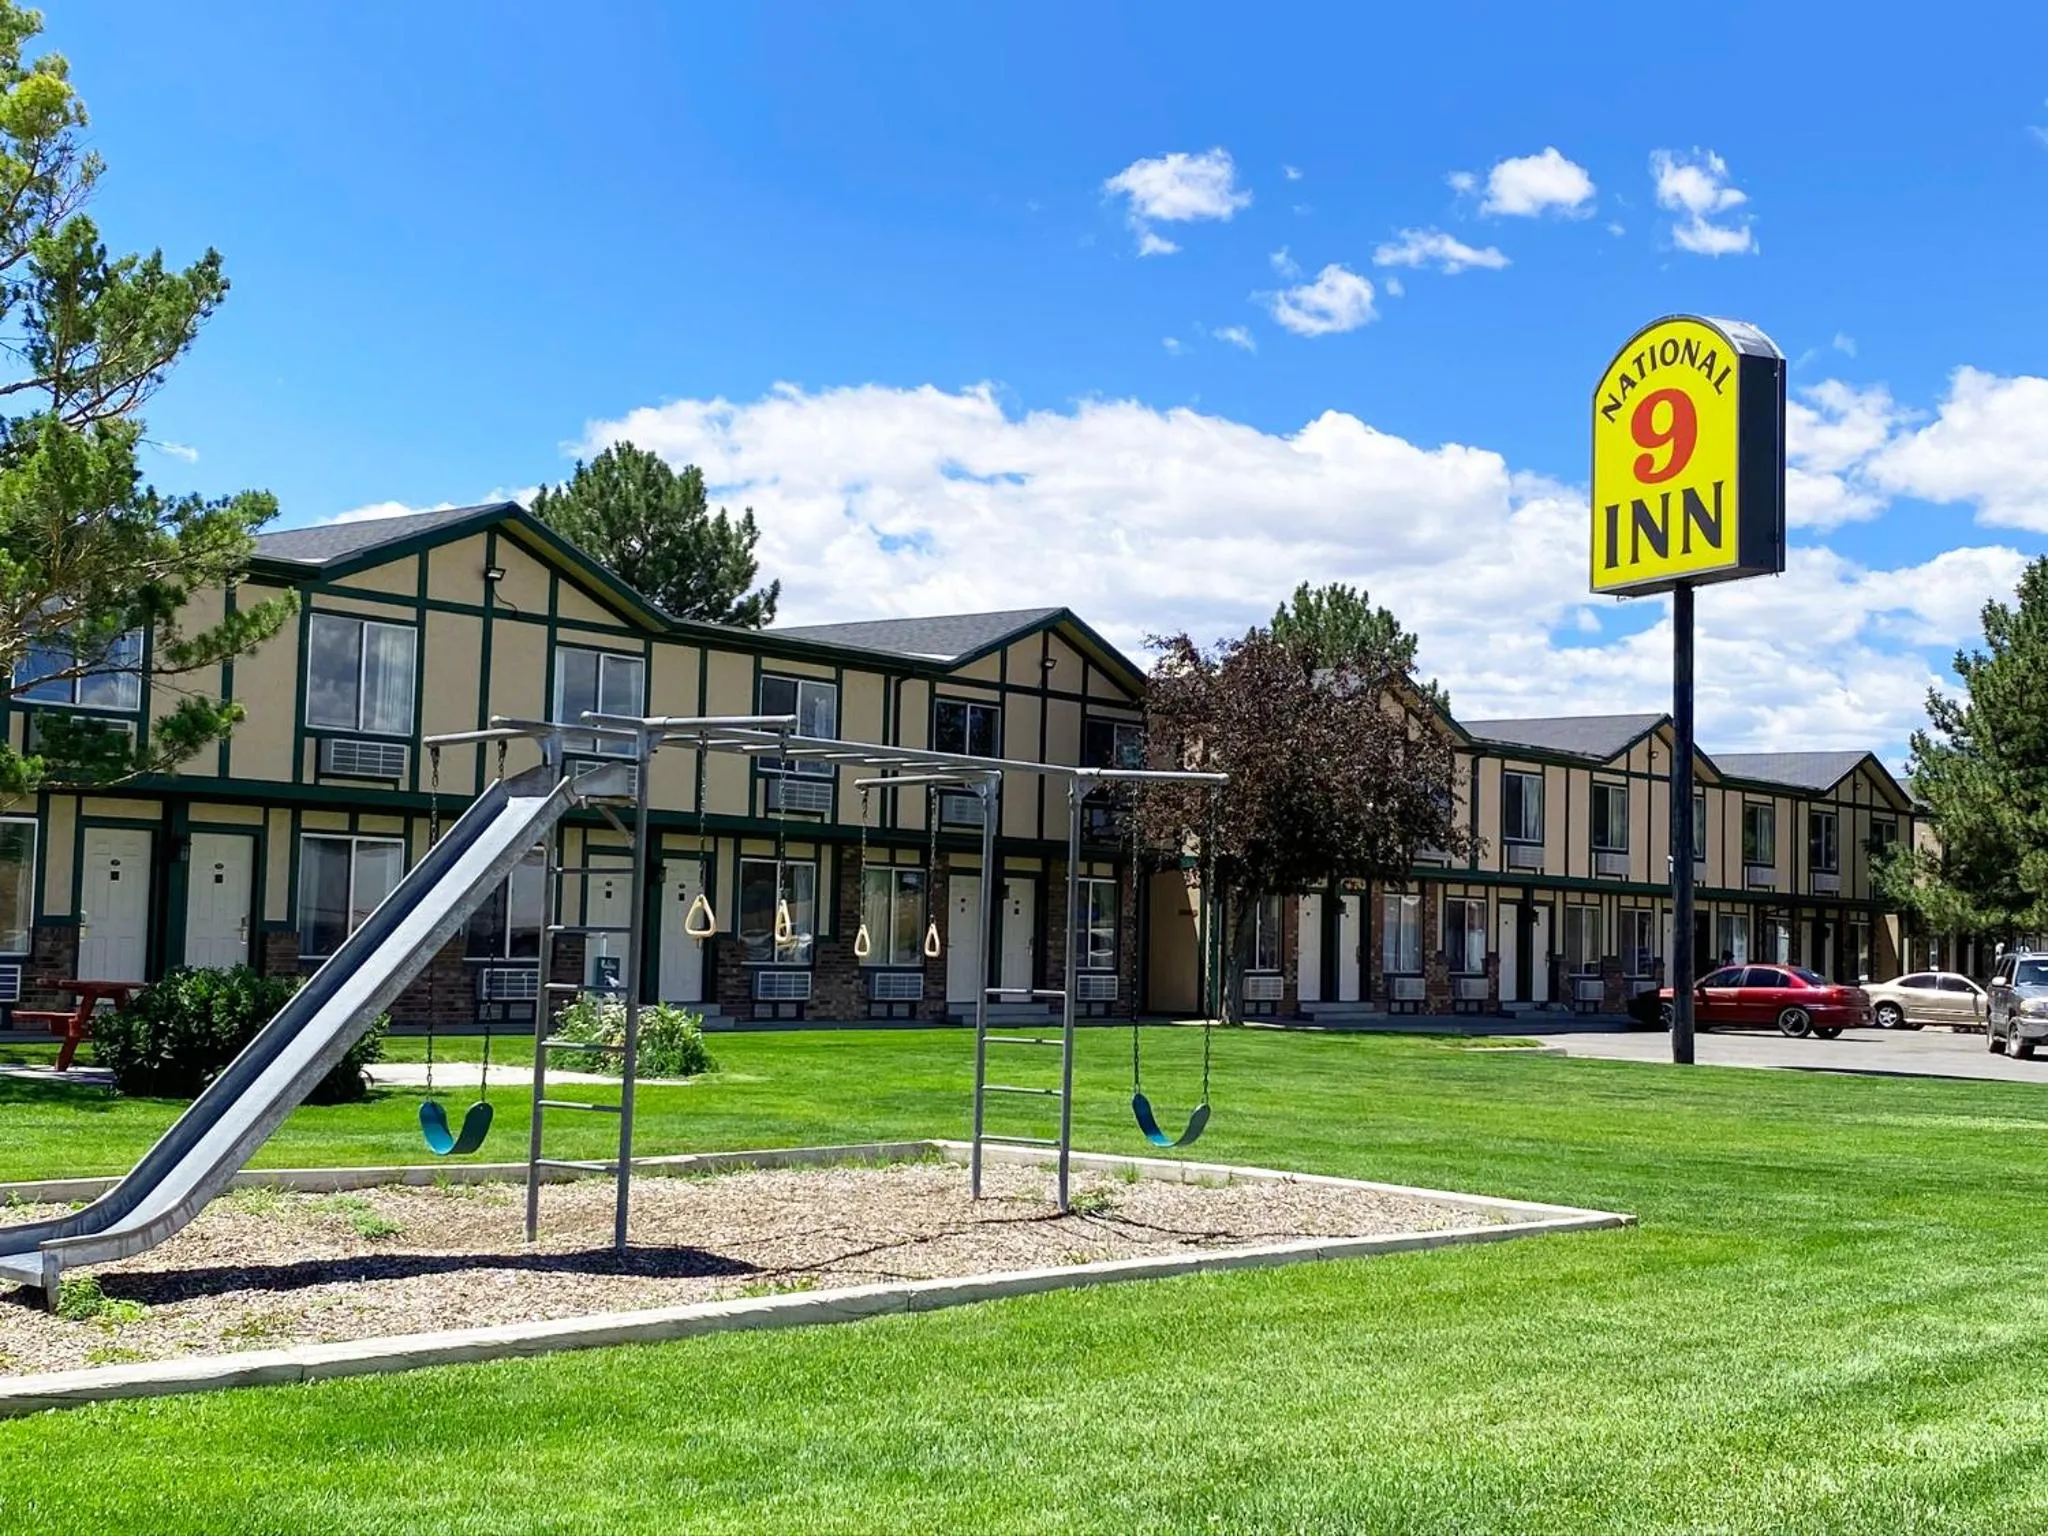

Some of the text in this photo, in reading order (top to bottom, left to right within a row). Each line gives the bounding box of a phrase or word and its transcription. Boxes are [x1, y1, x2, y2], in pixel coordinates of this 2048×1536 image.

[1601, 338, 1732, 423] NATIONAL
[1631, 388, 1698, 484] 9
[1604, 480, 1724, 570] INN
